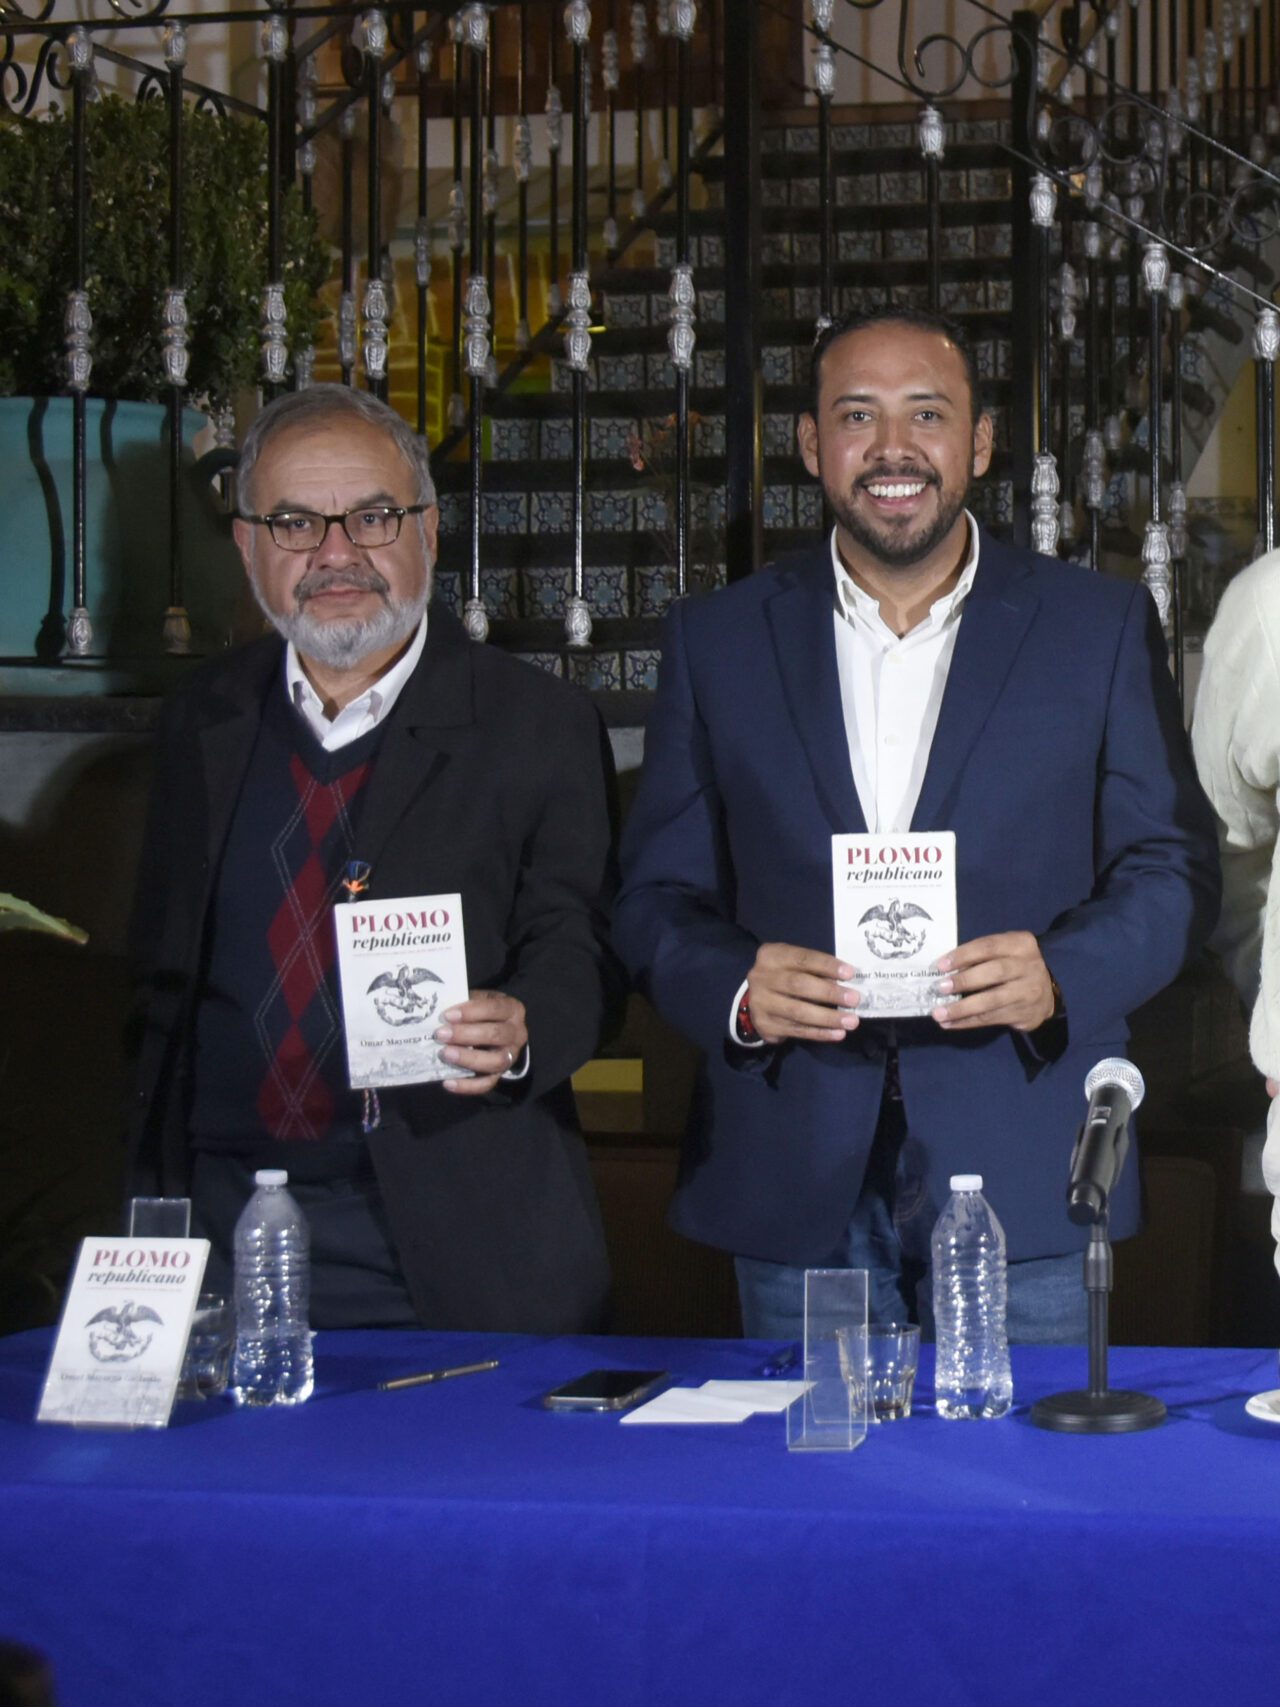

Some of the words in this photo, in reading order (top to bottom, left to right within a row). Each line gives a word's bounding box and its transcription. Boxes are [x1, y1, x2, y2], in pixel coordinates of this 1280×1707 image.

[847, 845, 943, 866] PLOMO
[847, 865, 943, 884] republicano
[352, 909, 450, 933] PLOMO
[353, 932, 452, 951] republicano
[855, 971, 871, 979] mar
[874, 970, 908, 979] Mayorga
[92, 1249, 191, 1269] PLOMO
[87, 1268, 186, 1286] republicano
